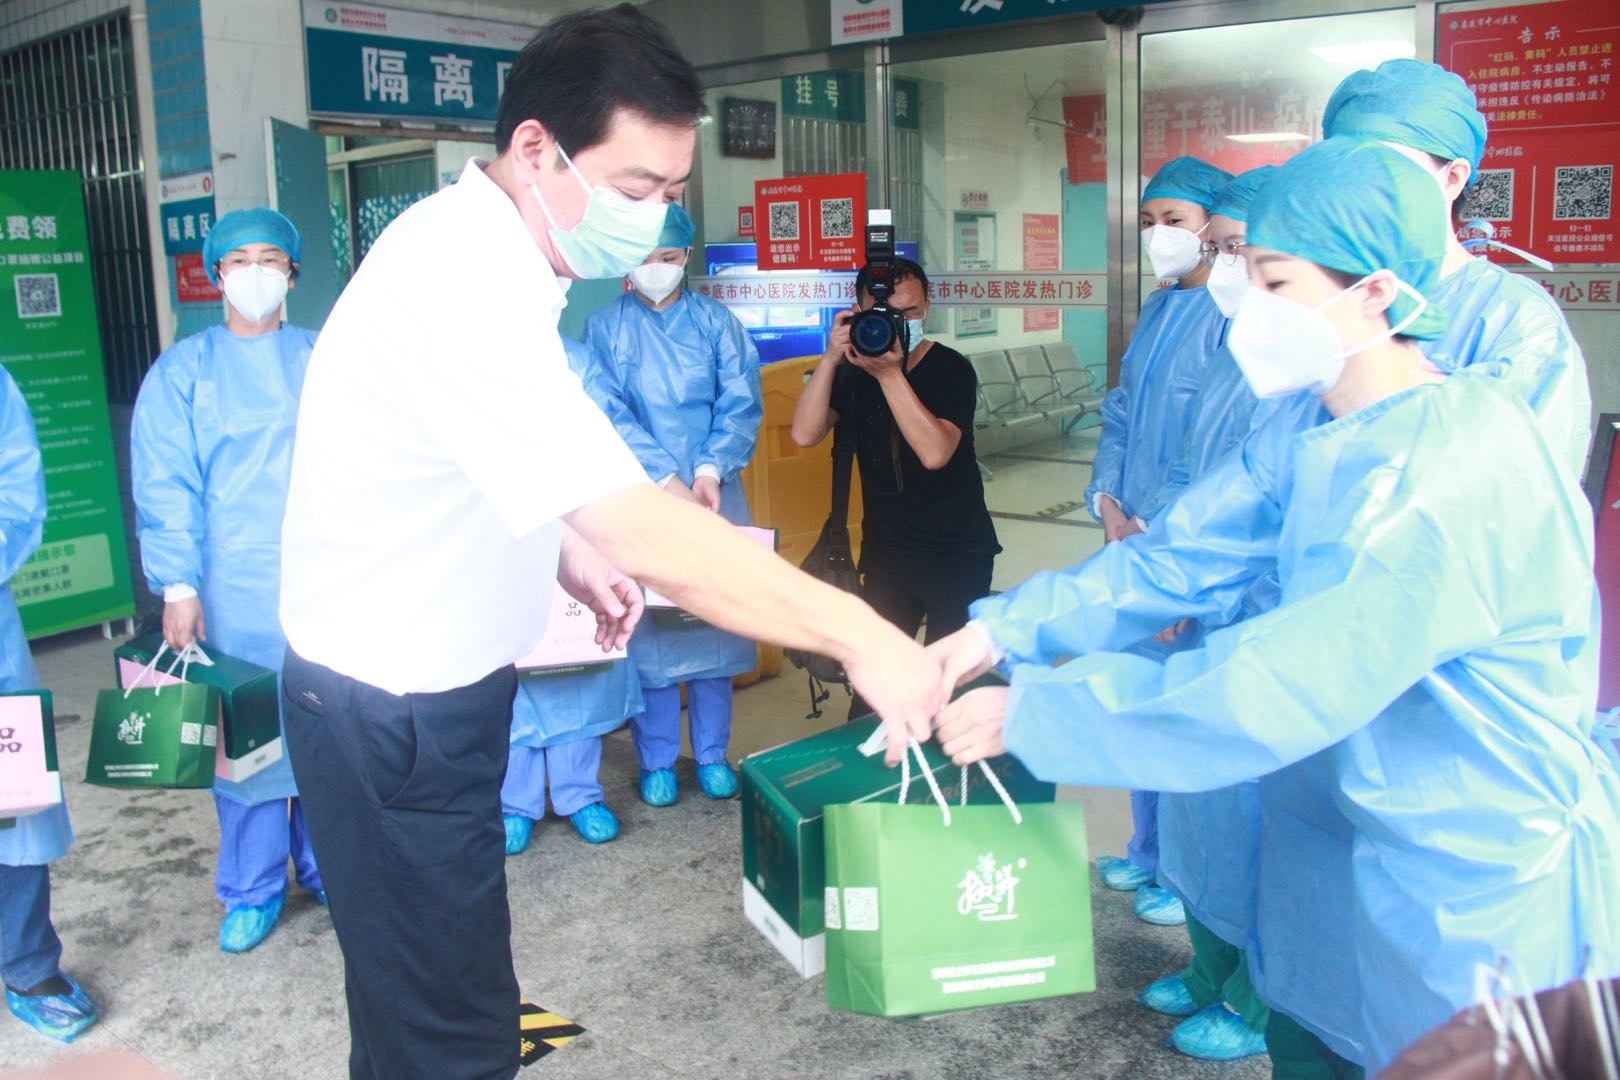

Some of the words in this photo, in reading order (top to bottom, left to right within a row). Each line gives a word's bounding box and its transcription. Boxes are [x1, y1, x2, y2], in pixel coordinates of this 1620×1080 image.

[1518, 26, 1561, 44] 告示
[361, 45, 512, 109] 隔离
[796, 75, 840, 108] 挂号
[0, 215, 57, 240] 费领
[1540, 279, 1620, 303] 心医
